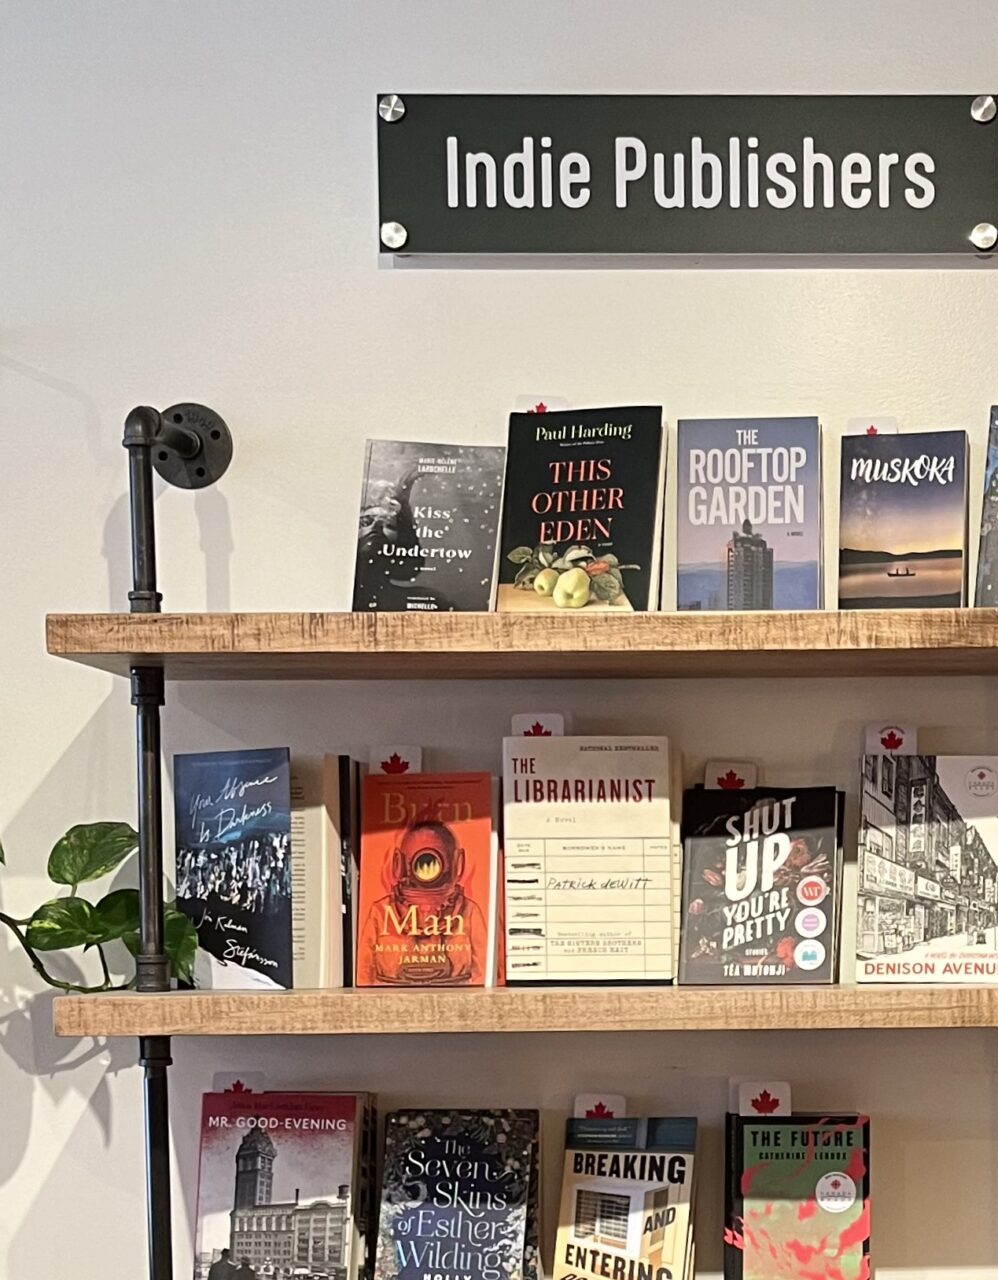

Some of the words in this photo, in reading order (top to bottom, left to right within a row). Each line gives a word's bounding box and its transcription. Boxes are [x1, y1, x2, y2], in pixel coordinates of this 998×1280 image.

[447, 136, 591, 208] Indie
[615, 136, 936, 208] Publishers
[536, 425, 566, 441] Paul
[571, 423, 633, 440] Harding
[736, 429, 759, 445] THE
[549, 459, 611, 483] THIS
[689, 447, 807, 484] ROOFTOP
[413, 506, 451, 519] Kiss
[531, 487, 624, 514] OTHER
[688, 485, 804, 525] GARDEN
[416, 526, 444, 539] the
[540, 518, 613, 544] EDEN
[382, 544, 472, 559] Undertow
[512, 758, 536, 774] THE
[514, 779, 656, 803] LIBRARIANIST
[214, 801, 272, 839] Darkness
[725, 797, 796, 847] SHUT
[724, 832, 792, 901] UP
[547, 877, 597, 889] PATRICK
[723, 887, 789, 926] YOU'RE
[381, 904, 465, 936] Man
[722, 908, 791, 950] PRETTY
[374, 943, 408, 952] MARK
[413, 943, 471, 952] ANTHONY
[397, 955, 446, 965] JARMAN
[724, 963, 740, 976] TÉA
[864, 962, 935, 975] DENISON
[209, 1116, 232, 1127] MR.
[236, 1117, 347, 1130] GOOD-EVENING
[444, 1140, 471, 1157] The
[751, 1131, 781, 1147] THE
[791, 1131, 854, 1147] FUTURE
[406, 1150, 500, 1180] Seven
[573, 1152, 686, 1184] BREAKING
[433, 1181, 507, 1218] Skins
[398, 1216, 416, 1235] of
[416, 1210, 504, 1247] Esther
[643, 1207, 676, 1235] AND
